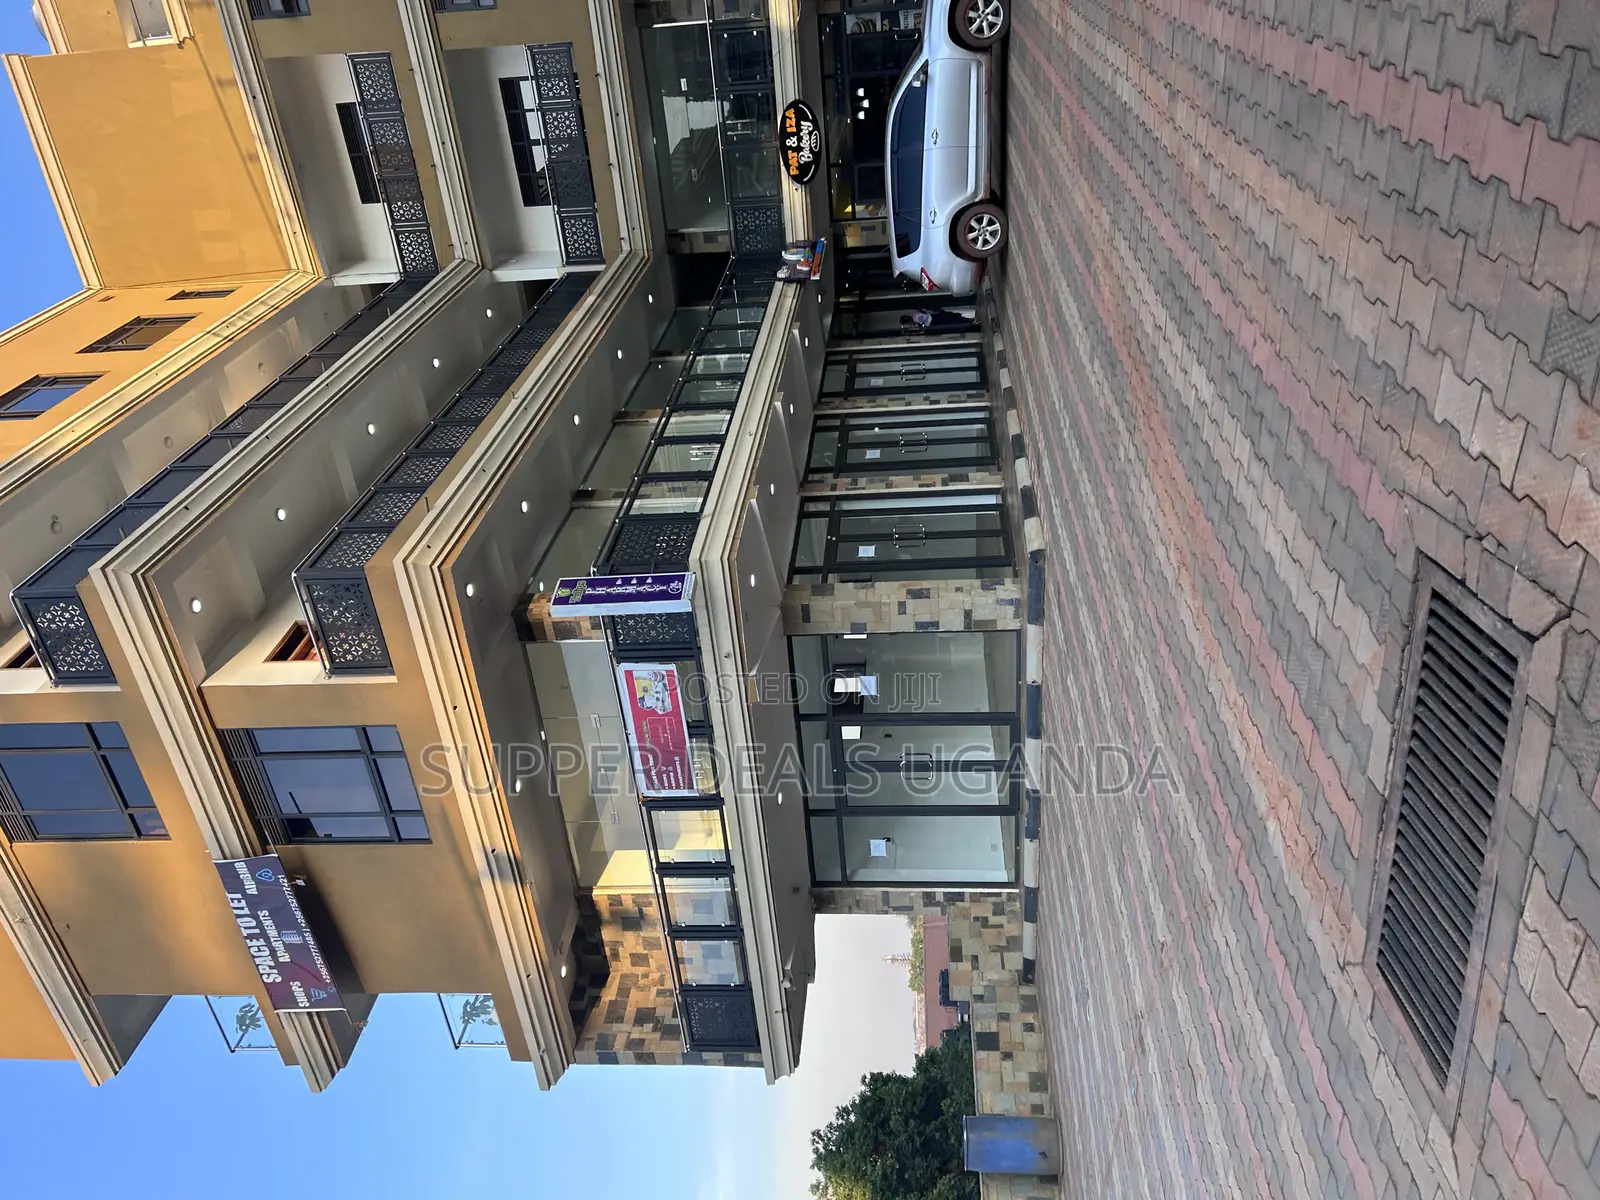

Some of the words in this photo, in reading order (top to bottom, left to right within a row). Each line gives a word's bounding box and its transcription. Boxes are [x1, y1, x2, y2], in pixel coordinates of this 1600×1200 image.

[785, 108, 797, 132] IZA
[786, 136, 798, 147] &
[798, 120, 813, 164] Bakery
[788, 149, 799, 175] PAT
[585, 584, 666, 594] PHARMACY
[234, 862, 258, 894] AIRBNB
[226, 891, 248, 914] LET
[240, 917, 260, 936] TO
[258, 910, 291, 962] APARTMENTS
[245, 938, 282, 983] SPACE
[290, 981, 310, 1007] SHOPS
